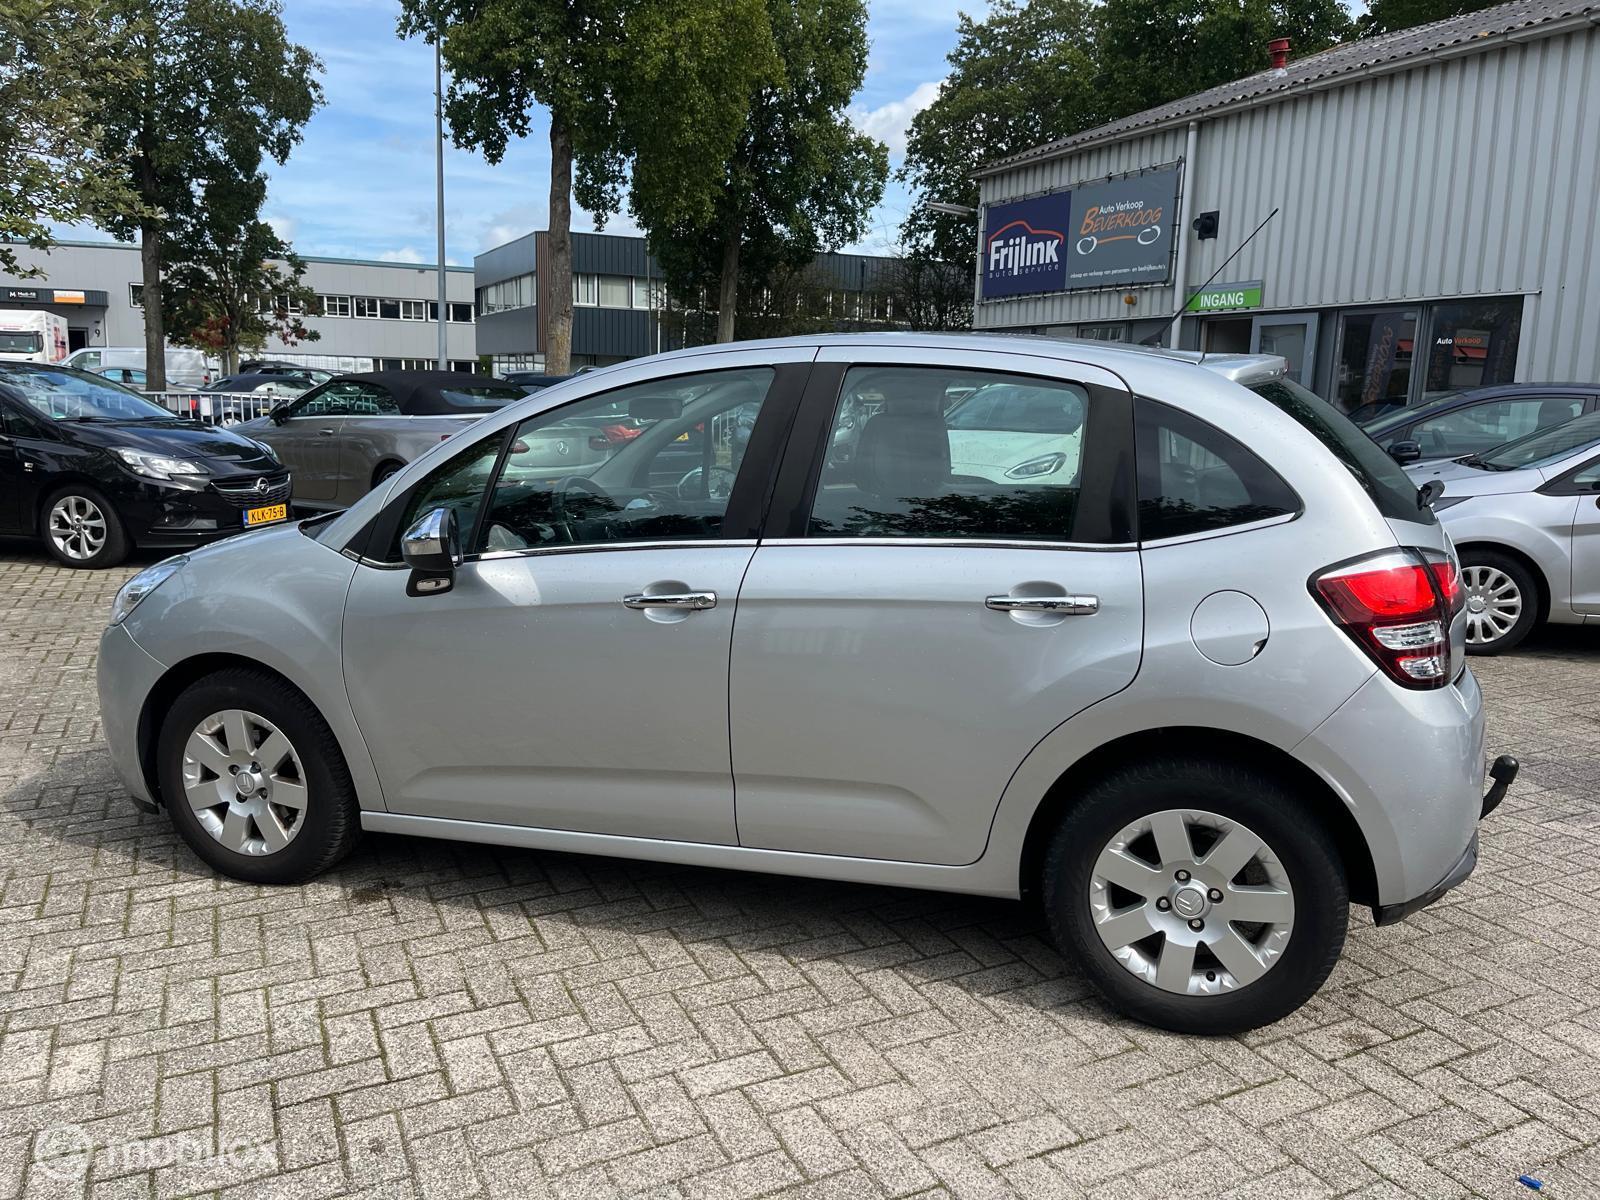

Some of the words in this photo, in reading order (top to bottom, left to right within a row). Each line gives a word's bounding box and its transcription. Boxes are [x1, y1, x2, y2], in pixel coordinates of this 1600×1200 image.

[1099, 206, 1114, 214] Auto
[1116, 200, 1144, 211] Verkoop
[1200, 292, 1244, 307] INGANG
[1436, 337, 1453, 345] Auto
[251, 506, 284, 522] KLK-75-B
